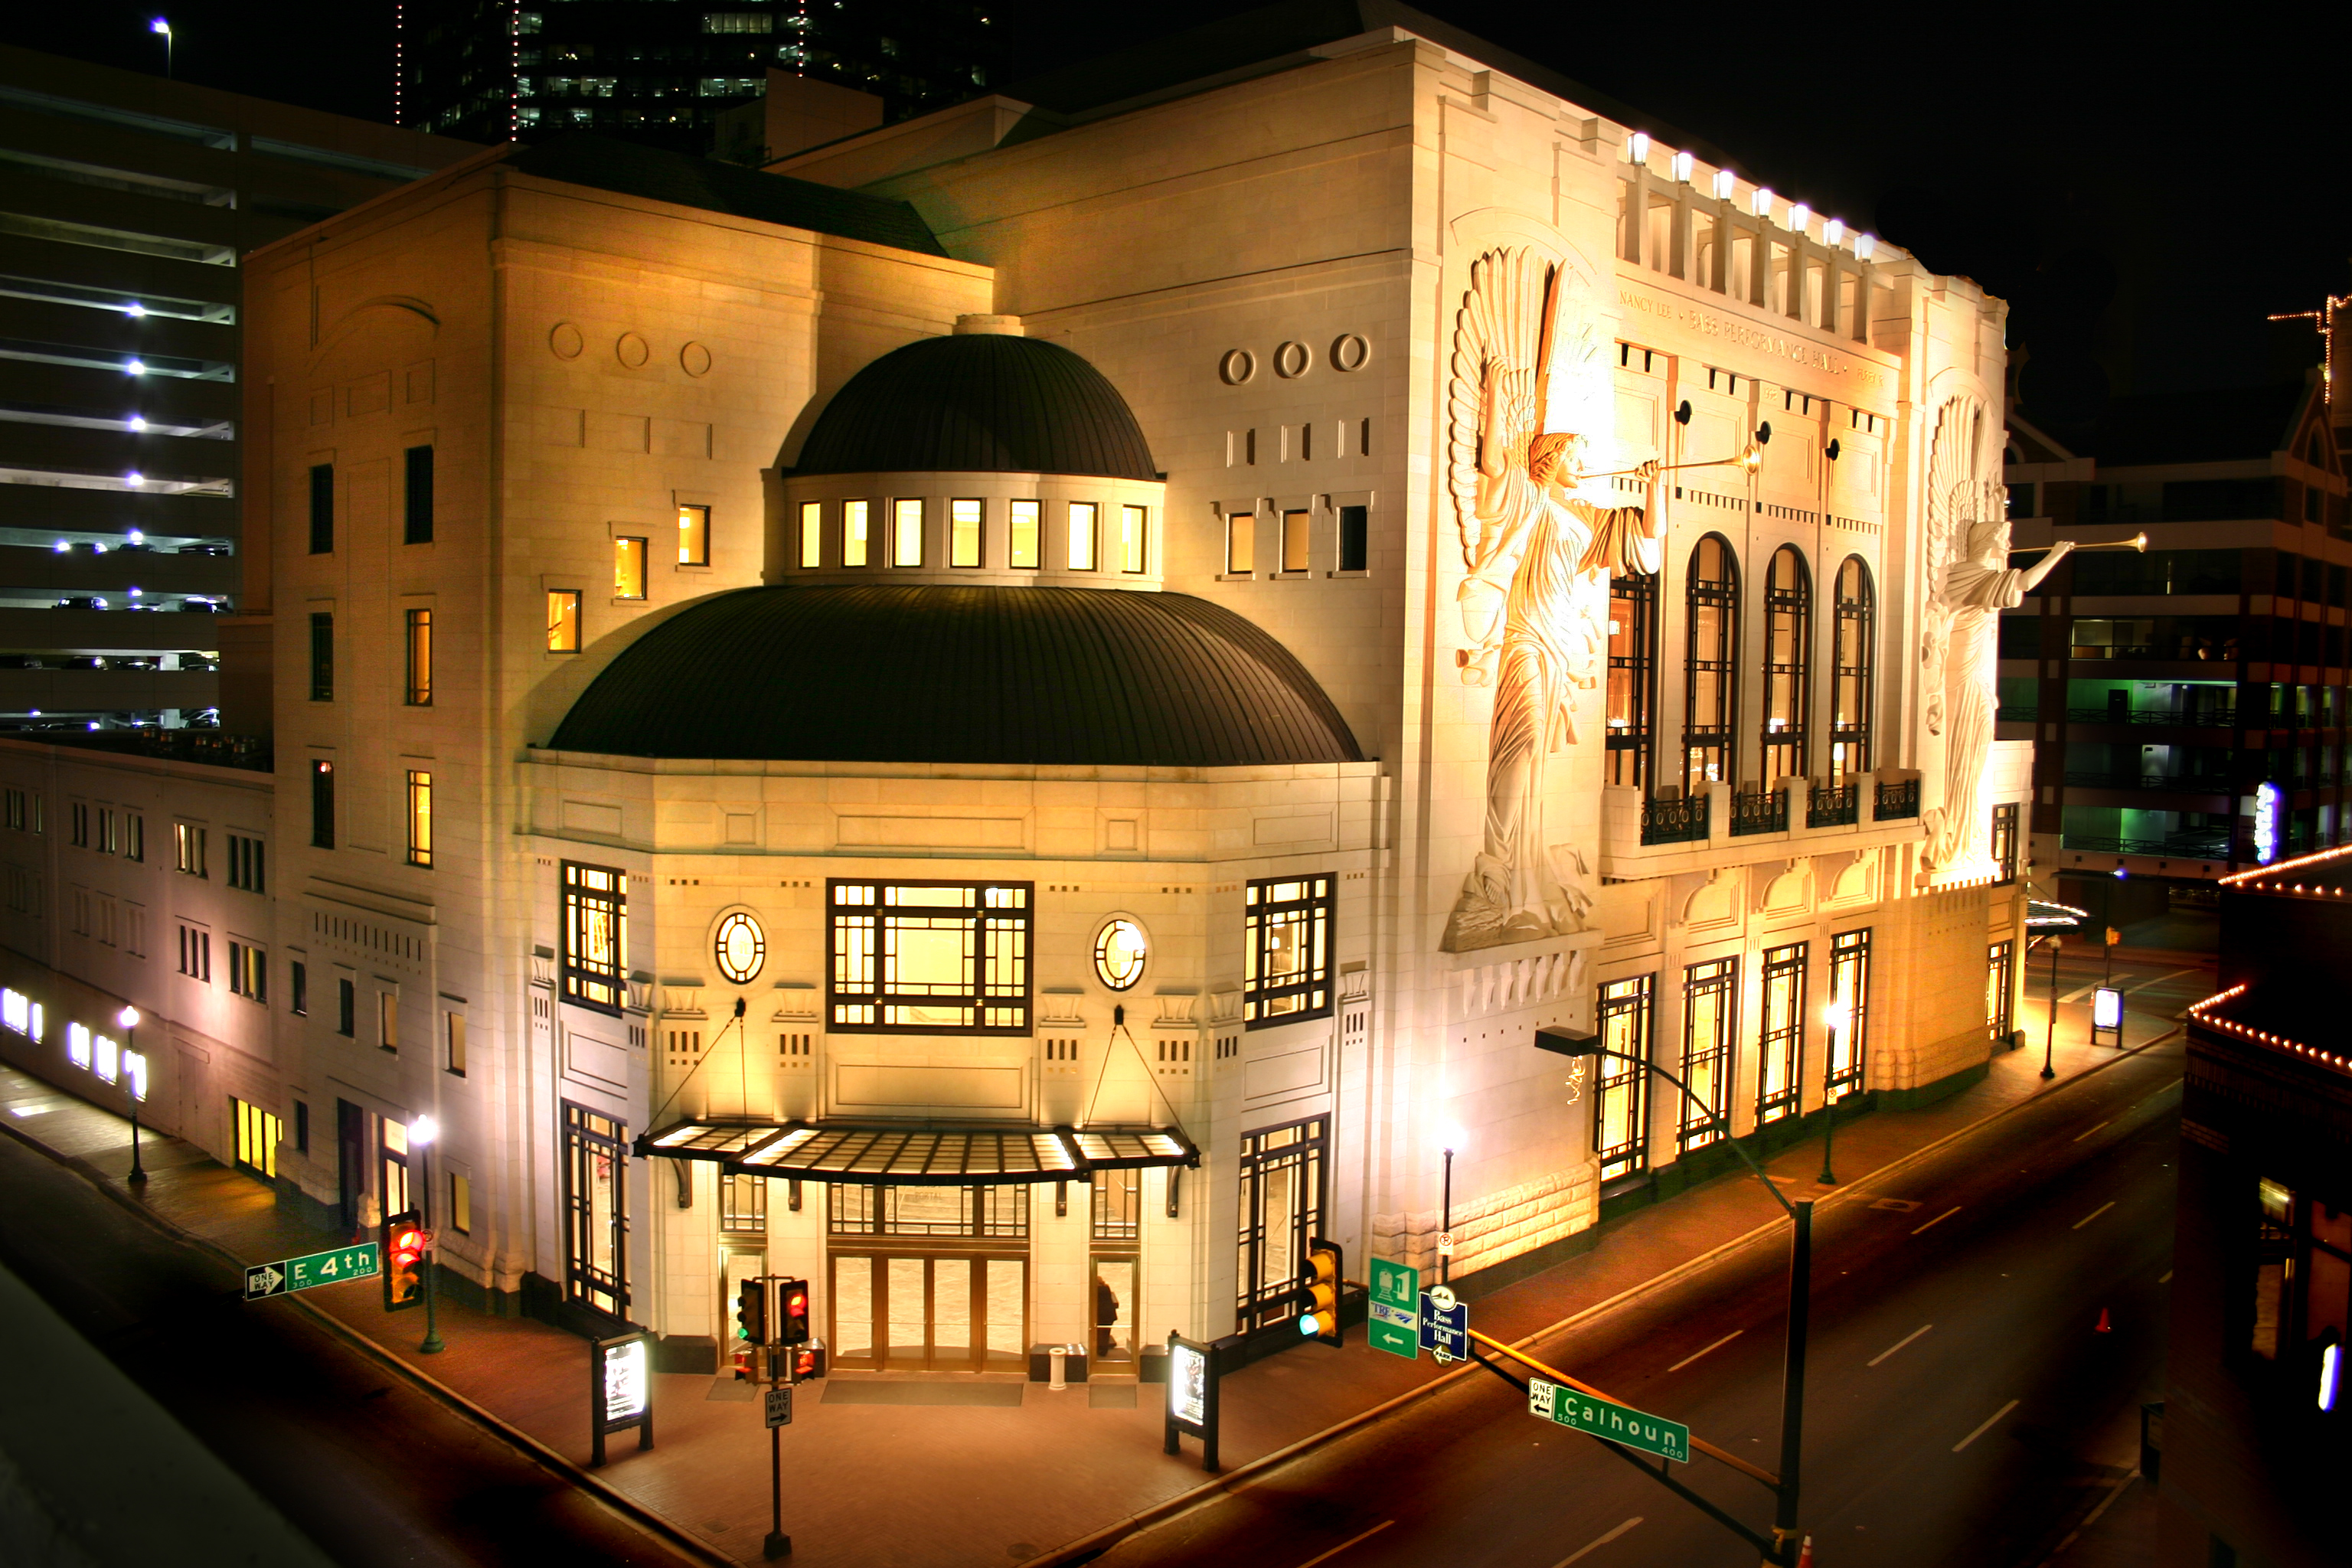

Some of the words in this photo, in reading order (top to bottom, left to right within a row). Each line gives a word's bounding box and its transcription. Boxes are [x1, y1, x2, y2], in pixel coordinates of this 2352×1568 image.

[1619, 290, 1654, 313] NANCY
[1657, 302, 1672, 319] LEE
[1688, 309, 1719, 337] BASS
[1724, 322, 1808, 365] PERFORMANCE
[1812, 350, 1840, 375] HALL
[294, 1263, 307, 1280] E
[320, 1251, 370, 1276] 4th
[353, 1266, 372, 1276] 200
[254, 1272, 273, 1283] ONE
[292, 1279, 312, 1289] 300
[254, 1280, 274, 1290] WAY
[1434, 1309, 1452, 1325] Bass
[1423, 1317, 1464, 1338] Performance
[1434, 1329, 1452, 1344] Hall
[1533, 1382, 1552, 1395] ONE
[768, 1390, 789, 1403] ONE
[1531, 1393, 1551, 1405] WAY
[768, 1401, 789, 1413] WAY
[1557, 1413, 1577, 1426] 500
[1564, 1397, 1677, 1448] Calhoun
[1661, 1446, 1684, 1459] 400
